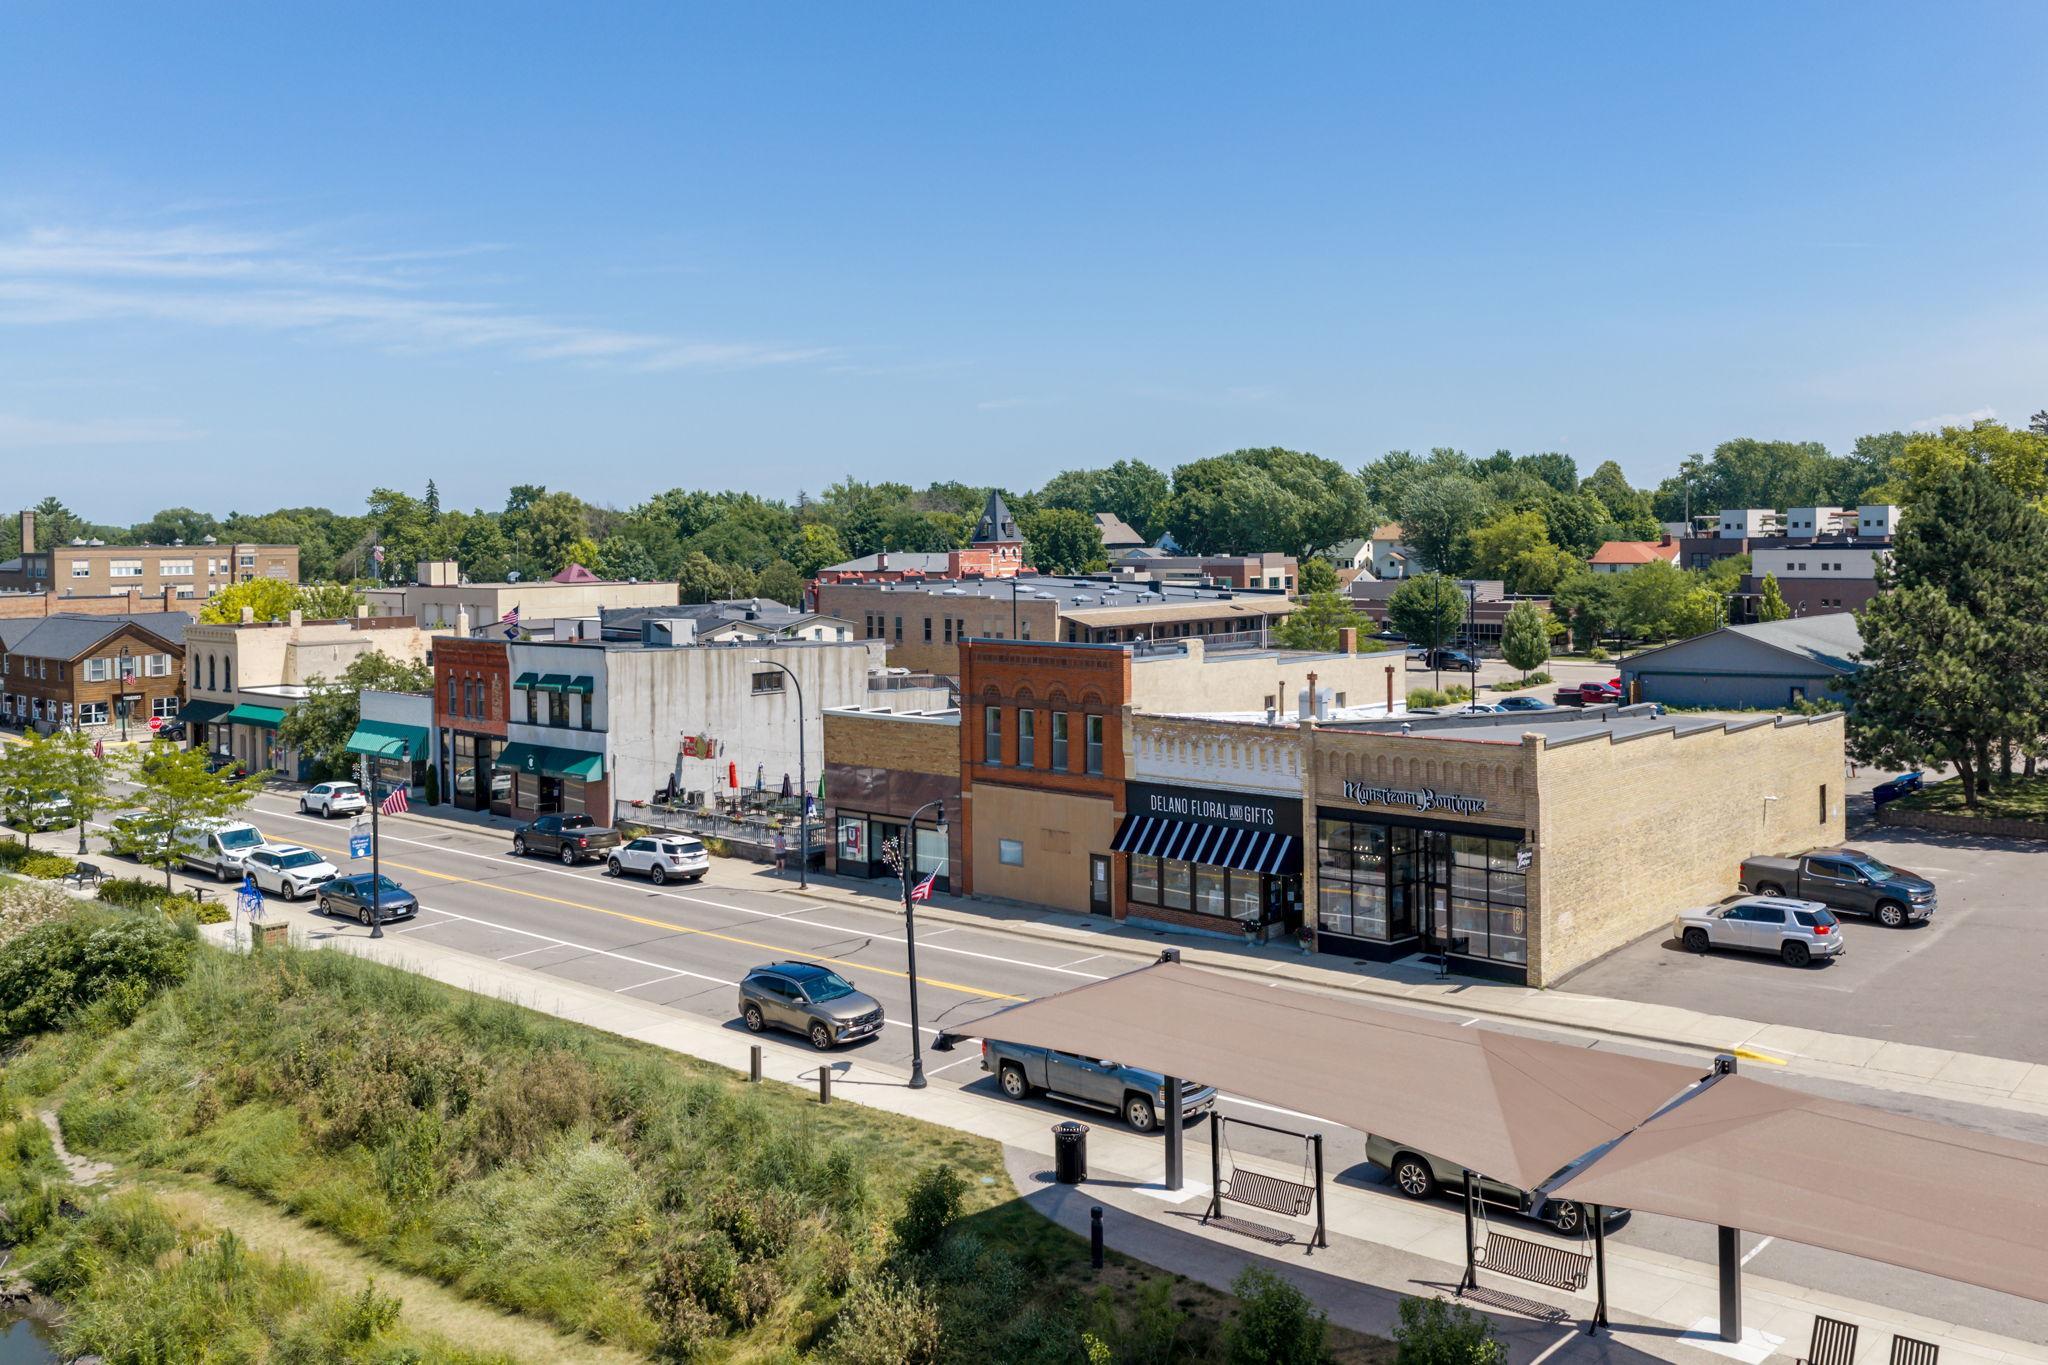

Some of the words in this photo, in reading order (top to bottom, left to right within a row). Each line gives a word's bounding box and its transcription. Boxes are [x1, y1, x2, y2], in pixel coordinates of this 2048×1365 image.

[1150, 794, 1188, 815] DELANO
[1191, 799, 1229, 820] FLORAL
[1229, 805, 1243, 820] AND
[1244, 805, 1274, 826] GIFTS
[1343, 780, 1416, 807] Mainstream
[1416, 787, 1486, 817] Boutique
